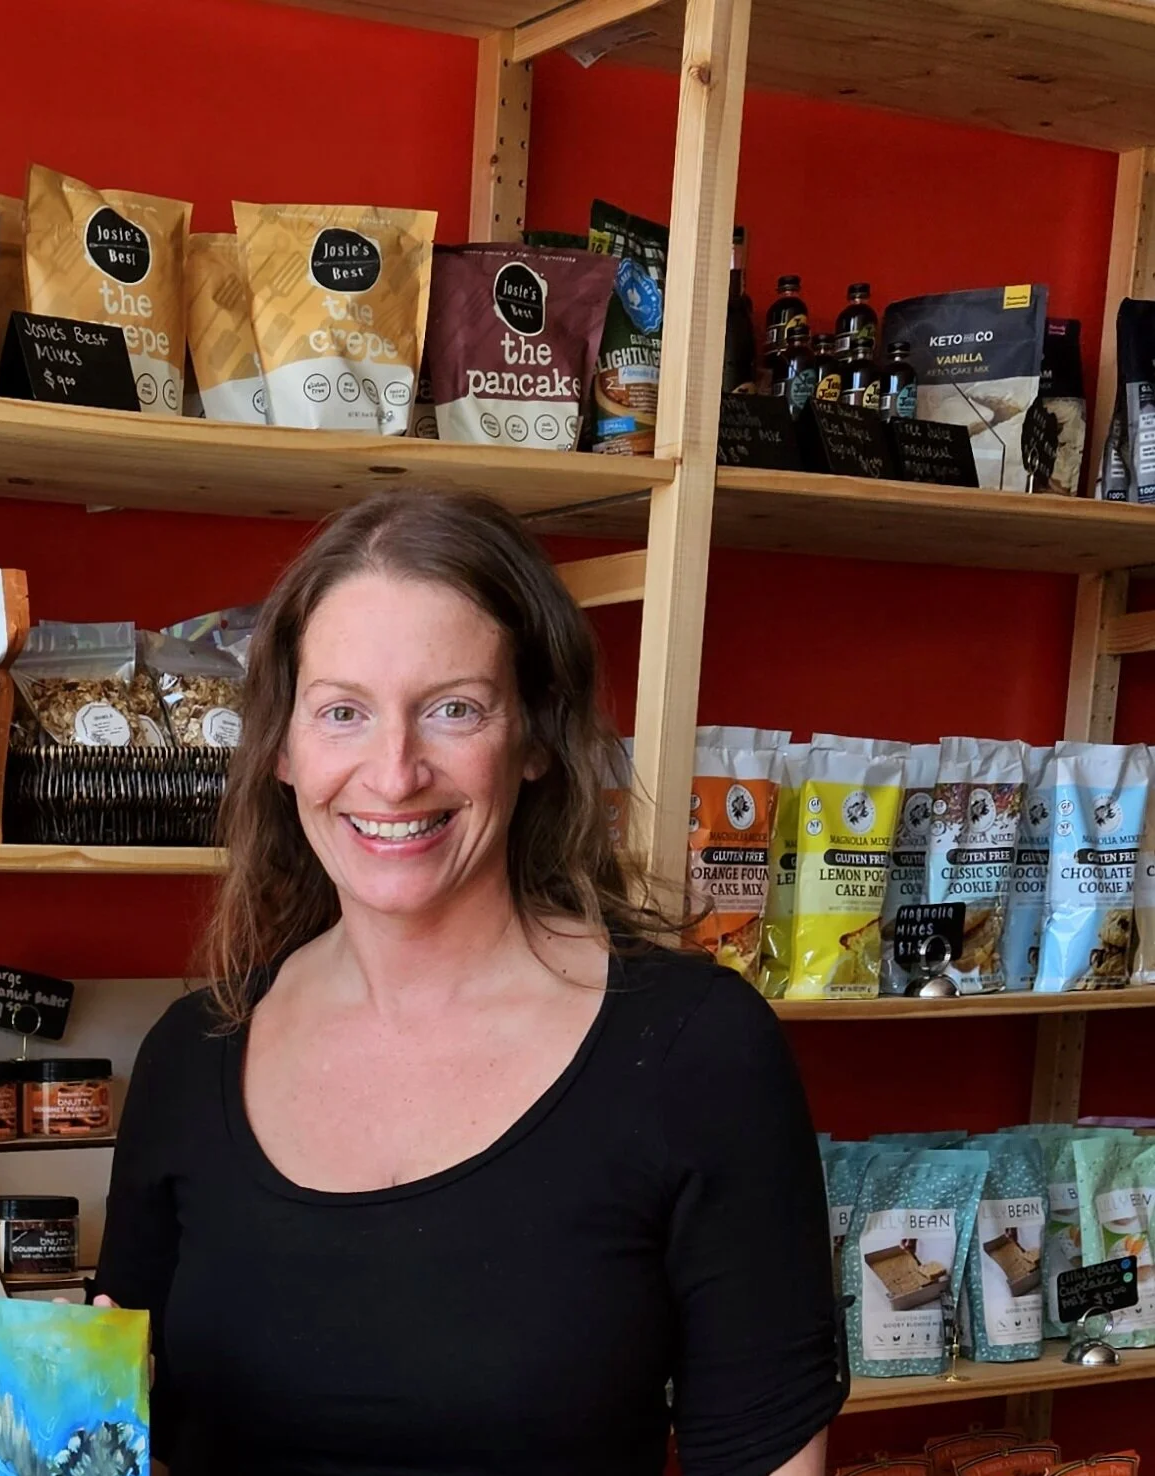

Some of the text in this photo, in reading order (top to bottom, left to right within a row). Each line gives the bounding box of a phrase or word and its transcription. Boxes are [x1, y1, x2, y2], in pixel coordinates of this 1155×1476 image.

[97, 224, 141, 243] Josie's
[108, 248, 136, 266] Best
[323, 242, 370, 259] Josie's
[332, 266, 365, 280] Best
[503, 279, 537, 301] Josie's
[98, 280, 153, 318] the
[322, 294, 374, 325] the
[24, 317, 108, 346] Josie's Best
[929, 331, 994, 347] KETO CO
[309, 329, 398, 362] crepe
[500, 332, 552, 366] the
[35, 342, 83, 366] Mixes
[936, 352, 983, 365] VANILLA
[951, 366, 972, 376] CAKE
[974, 365, 990, 374] MIX
[466, 368, 581, 399] pancake
[713, 851, 765, 862] GLUTEN FREE
[835, 852, 868, 864] GLUTEN
[988, 851, 1010, 861] FREE
[691, 867, 739, 880] ORANGE
[820, 868, 861, 881] LEMON
[710, 883, 764, 896] CAKE MIX
[835, 884, 866, 897] CAKE
[896, 923, 934, 935] Mixes
[34, 991, 70, 1008] Butter
[1008, 1203, 1040, 1218] BEAN
[910, 1214, 950, 1229] BEAN
[1059, 1276, 1118, 1297] Cupcake
